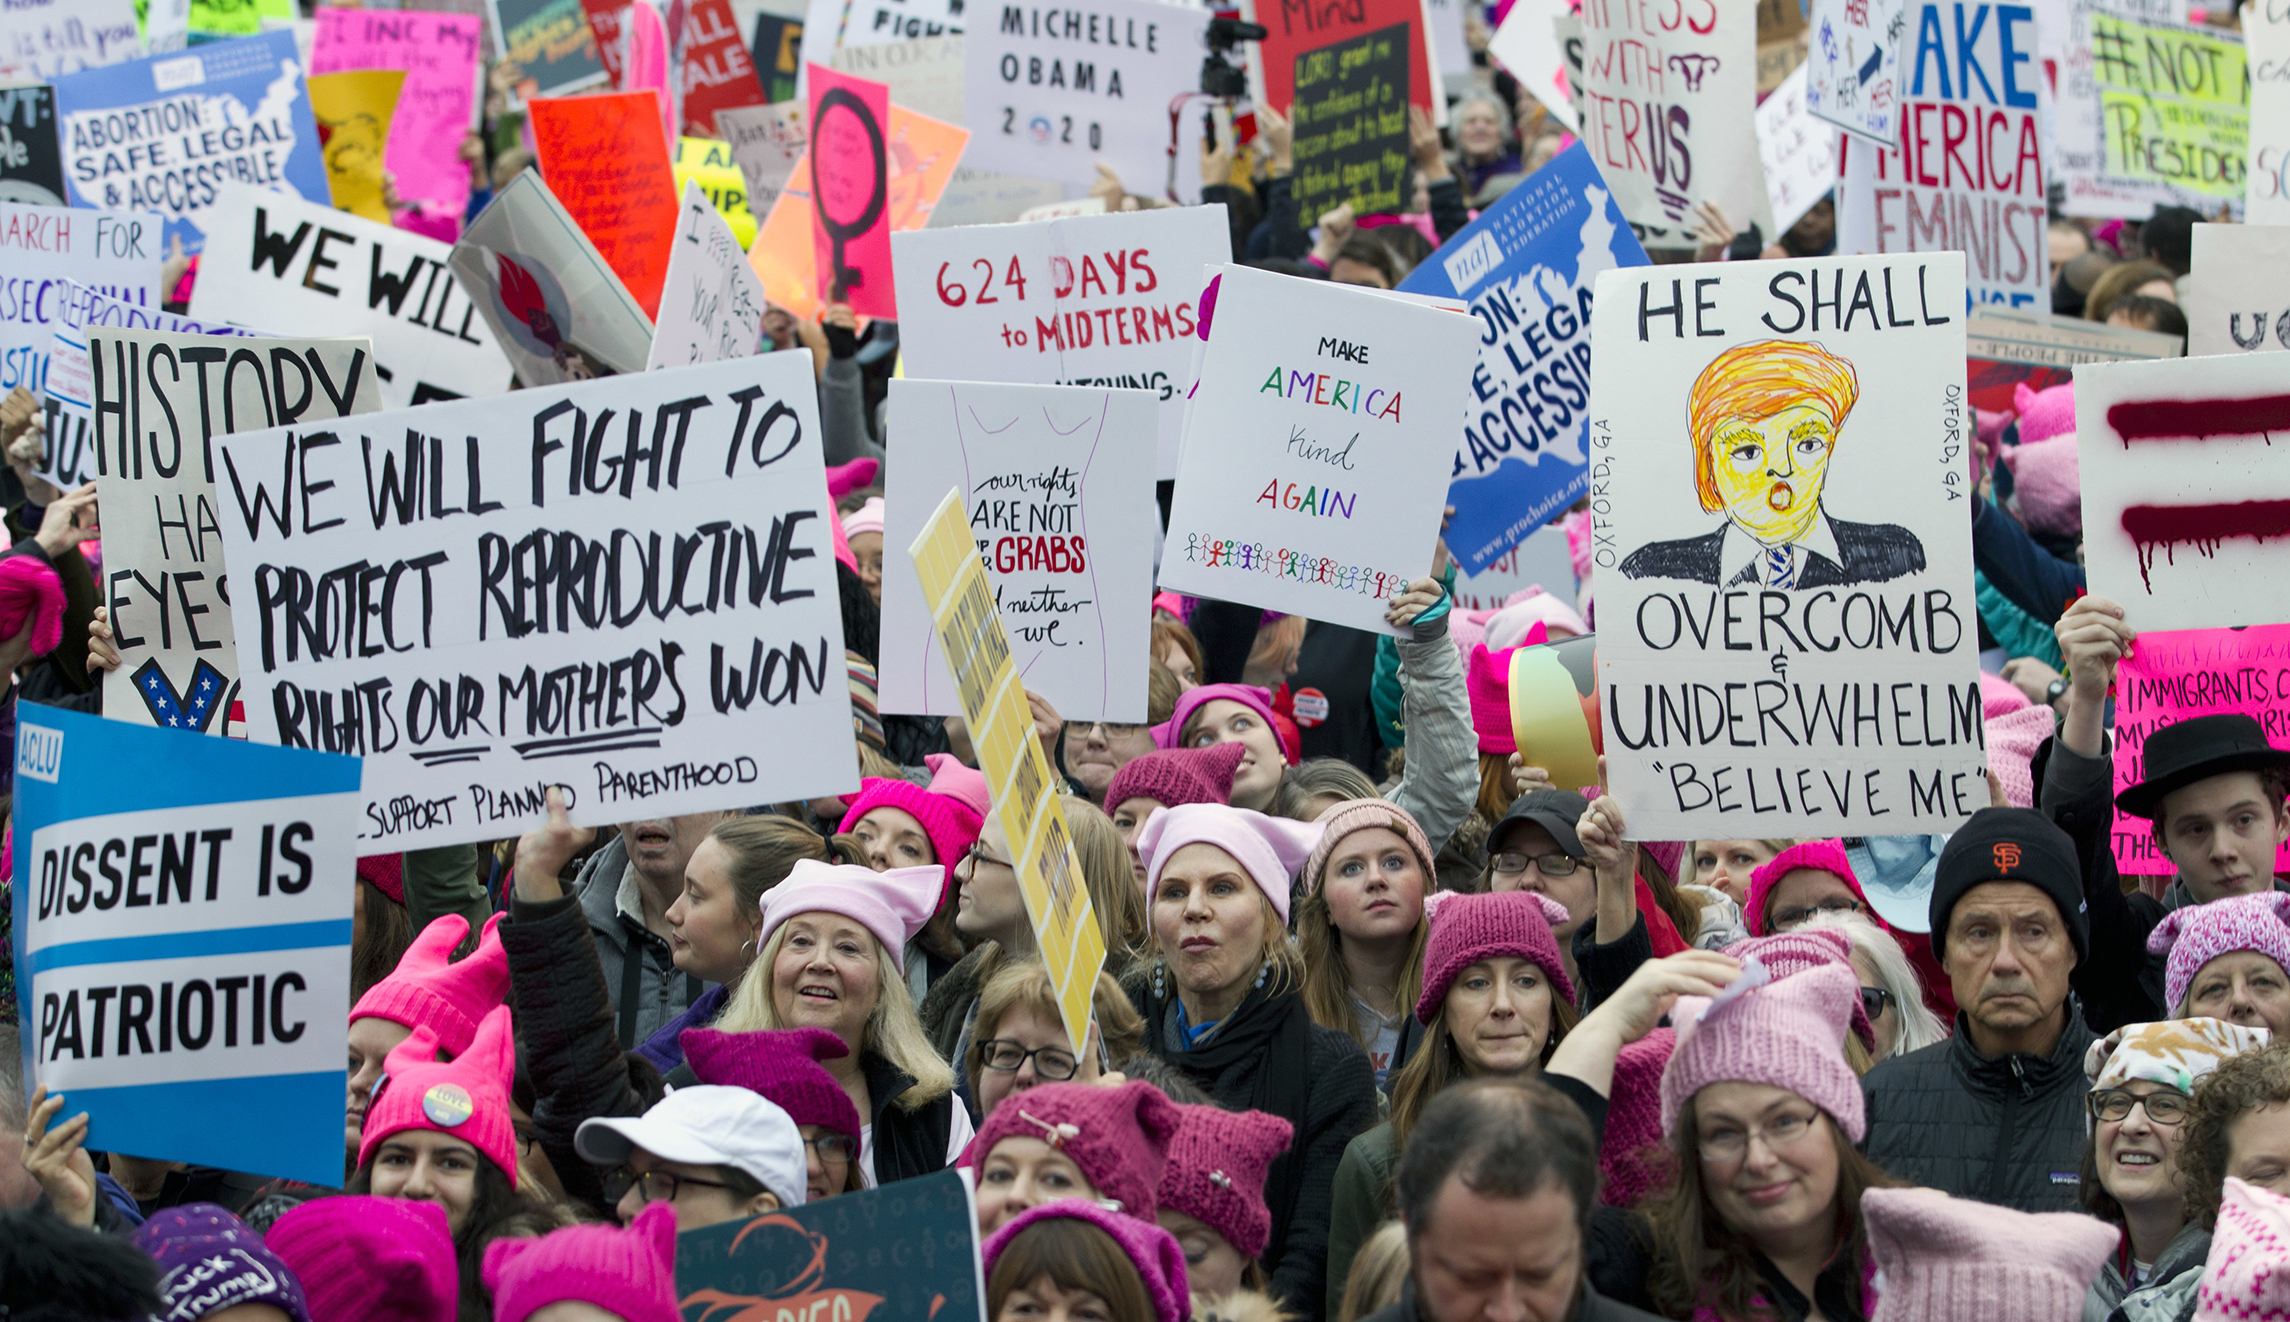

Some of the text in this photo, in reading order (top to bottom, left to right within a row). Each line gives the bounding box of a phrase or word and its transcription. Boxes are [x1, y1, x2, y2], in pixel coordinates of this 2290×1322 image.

[1000, 5, 1158, 54] MICHELLE
[1902, 3, 2039, 110] AKE
[685, 43, 752, 95] ALE
[1000, 53, 1124, 99] OBAMA
[72, 97, 213, 153] ABORTION:
[183, 118, 291, 161] LEGAL
[1840, 103, 2044, 198] MERICA
[104, 183, 121, 207] &
[686, 203, 704, 245] I
[1493, 173, 1562, 232] NATIONAL
[1498, 185, 1570, 246] ABORTION
[0, 212, 71, 254] ARCH
[95, 216, 147, 260] FOR
[1504, 199, 1577, 258] FEDERATION
[1875, 188, 2045, 288] EMINIST
[252, 206, 484, 346] WE WILL
[936, 248, 1158, 308] 624 DAYS
[1453, 233, 1492, 284] naf
[1001, 302, 1196, 354] to MIDTERMS
[1504, 286, 1593, 376] LEGA
[1638, 264, 1952, 342] HE SHALL
[1318, 337, 1369, 365] MAKE
[91, 338, 366, 484] HISTORY
[1260, 366, 1403, 424] AMERICA
[222, 430, 347, 541] WE
[361, 428, 505, 530] WILL
[532, 396, 713, 508] FIGHT
[726, 385, 802, 479] TO
[1939, 384, 1962, 501] OXFORD, GA
[973, 465, 1080, 502] our rights
[1256, 478, 1357, 520] AGAIN
[1593, 418, 1617, 569] OXFORD, GA
[155, 493, 225, 562] HA
[970, 499, 1079, 534] ARE NOT
[995, 536, 1086, 574] GRABS
[255, 510, 820, 674] PROTECT REPRODUCTIVE
[1007, 584, 1093, 614] neither
[1636, 589, 1962, 654] OVERCOMB
[1770, 644, 1789, 683] &
[2127, 667, 2273, 714] IMMIGRANTS,
[273, 676, 399, 757] RIGHTS
[407, 674, 494, 746] OUR
[711, 636, 828, 715] WON
[1609, 680, 1985, 751] UNDERWHELM
[19, 728, 61, 776] ACLU
[468, 780, 576, 825] PLANND
[593, 755, 759, 804] PARENTHOOD
[1652, 760, 1989, 820] "BELIEVE ME"
[38, 821, 315, 923] DISSENT IS
[39, 971, 308, 1065] PATRIOTIC
[435, 1086, 466, 1108] LOVE
